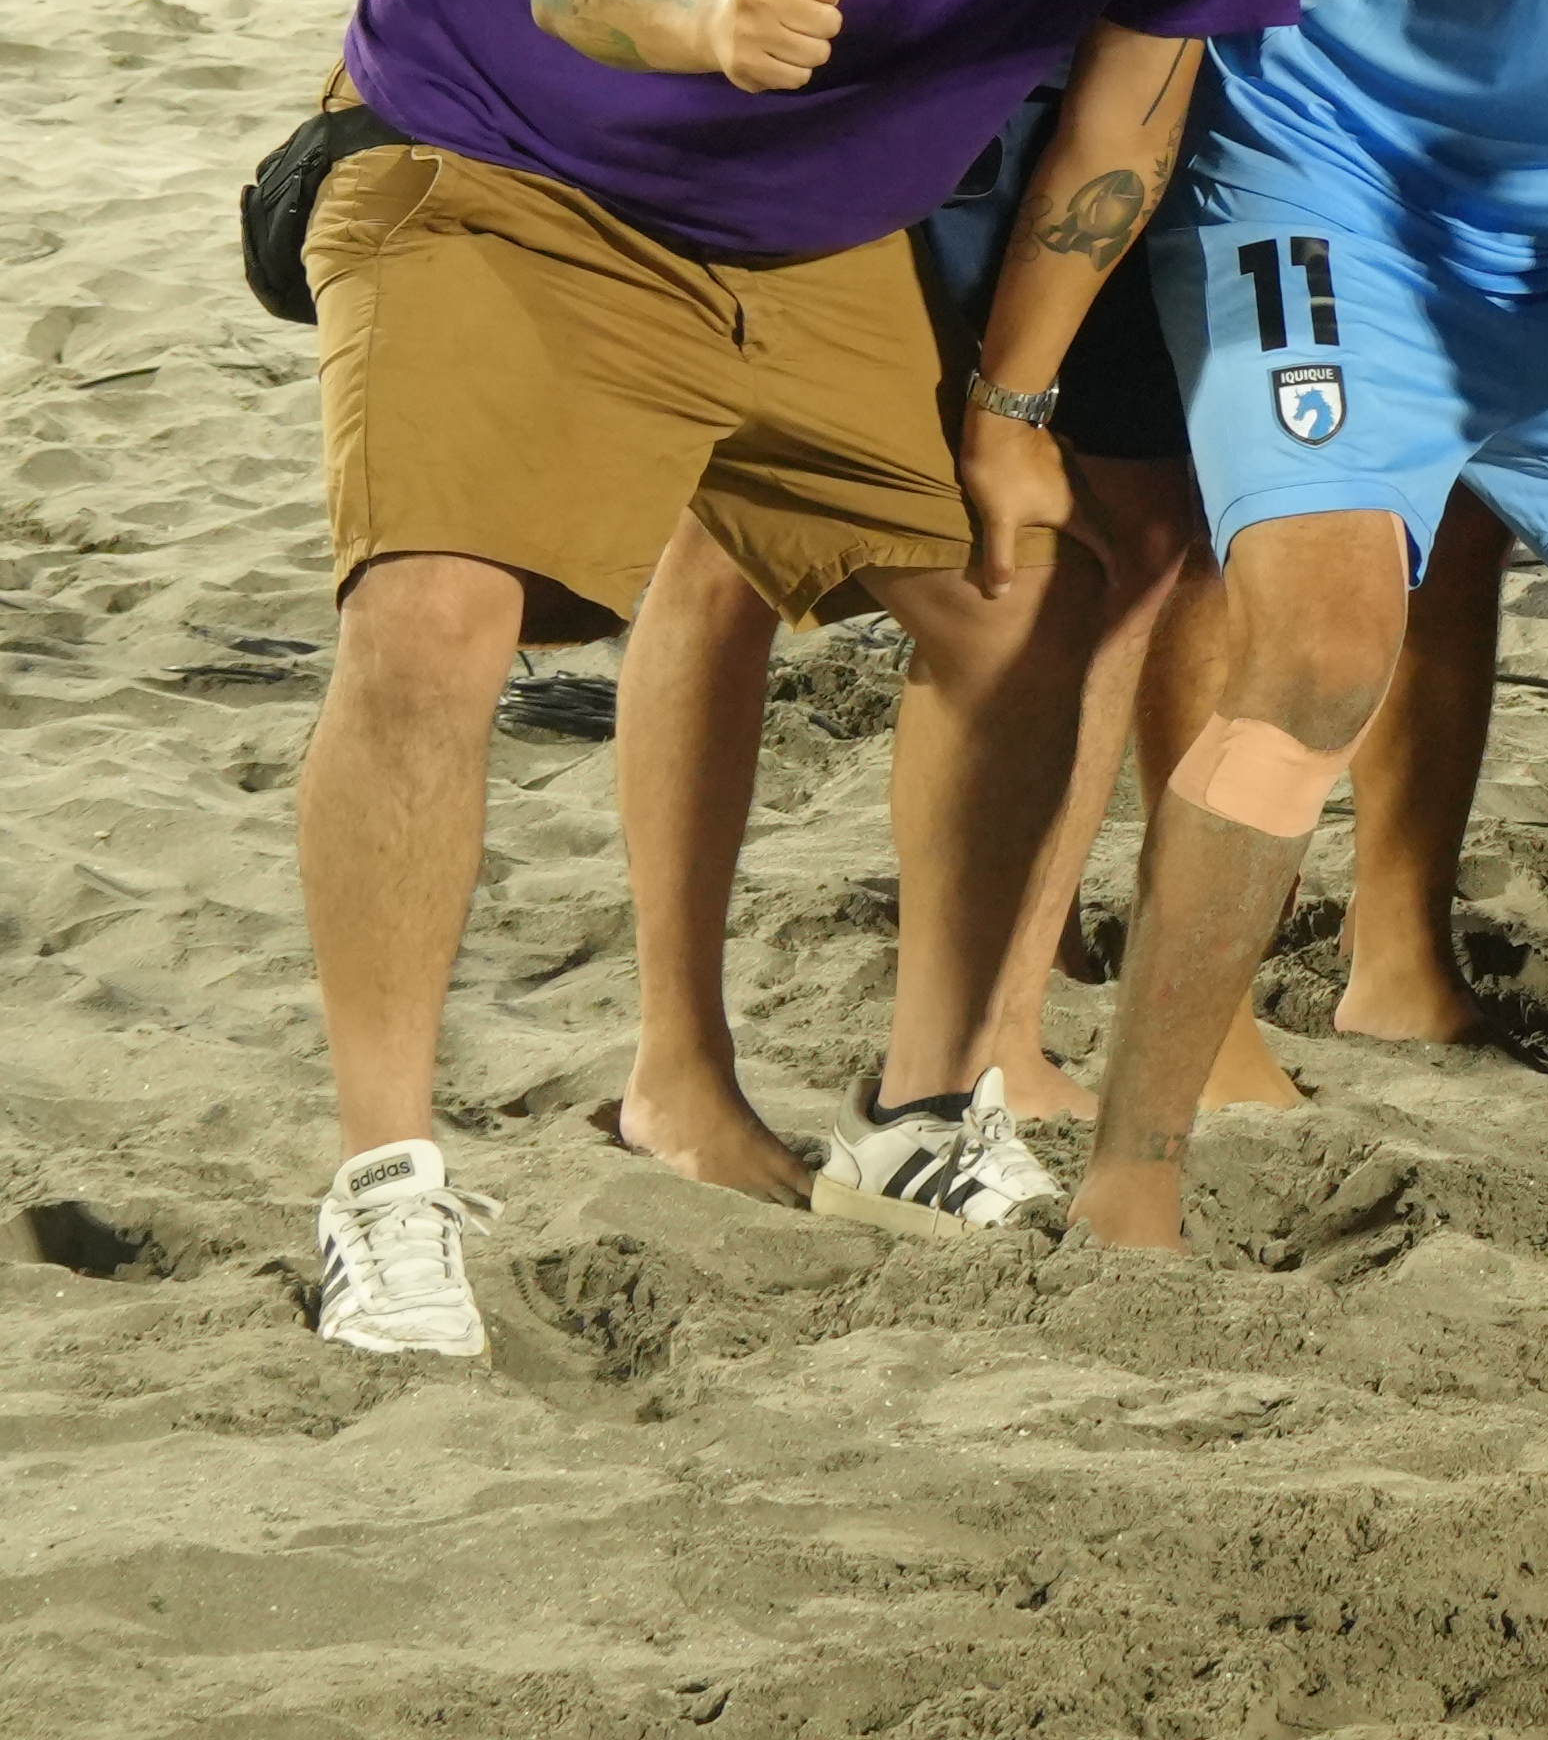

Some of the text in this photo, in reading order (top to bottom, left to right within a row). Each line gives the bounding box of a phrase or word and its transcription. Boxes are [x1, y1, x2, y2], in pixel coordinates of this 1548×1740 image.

[1237, 236, 1340, 352] 11
[1280, 367, 1335, 383] IQUIQUE
[348, 1159, 412, 1194] adidas
